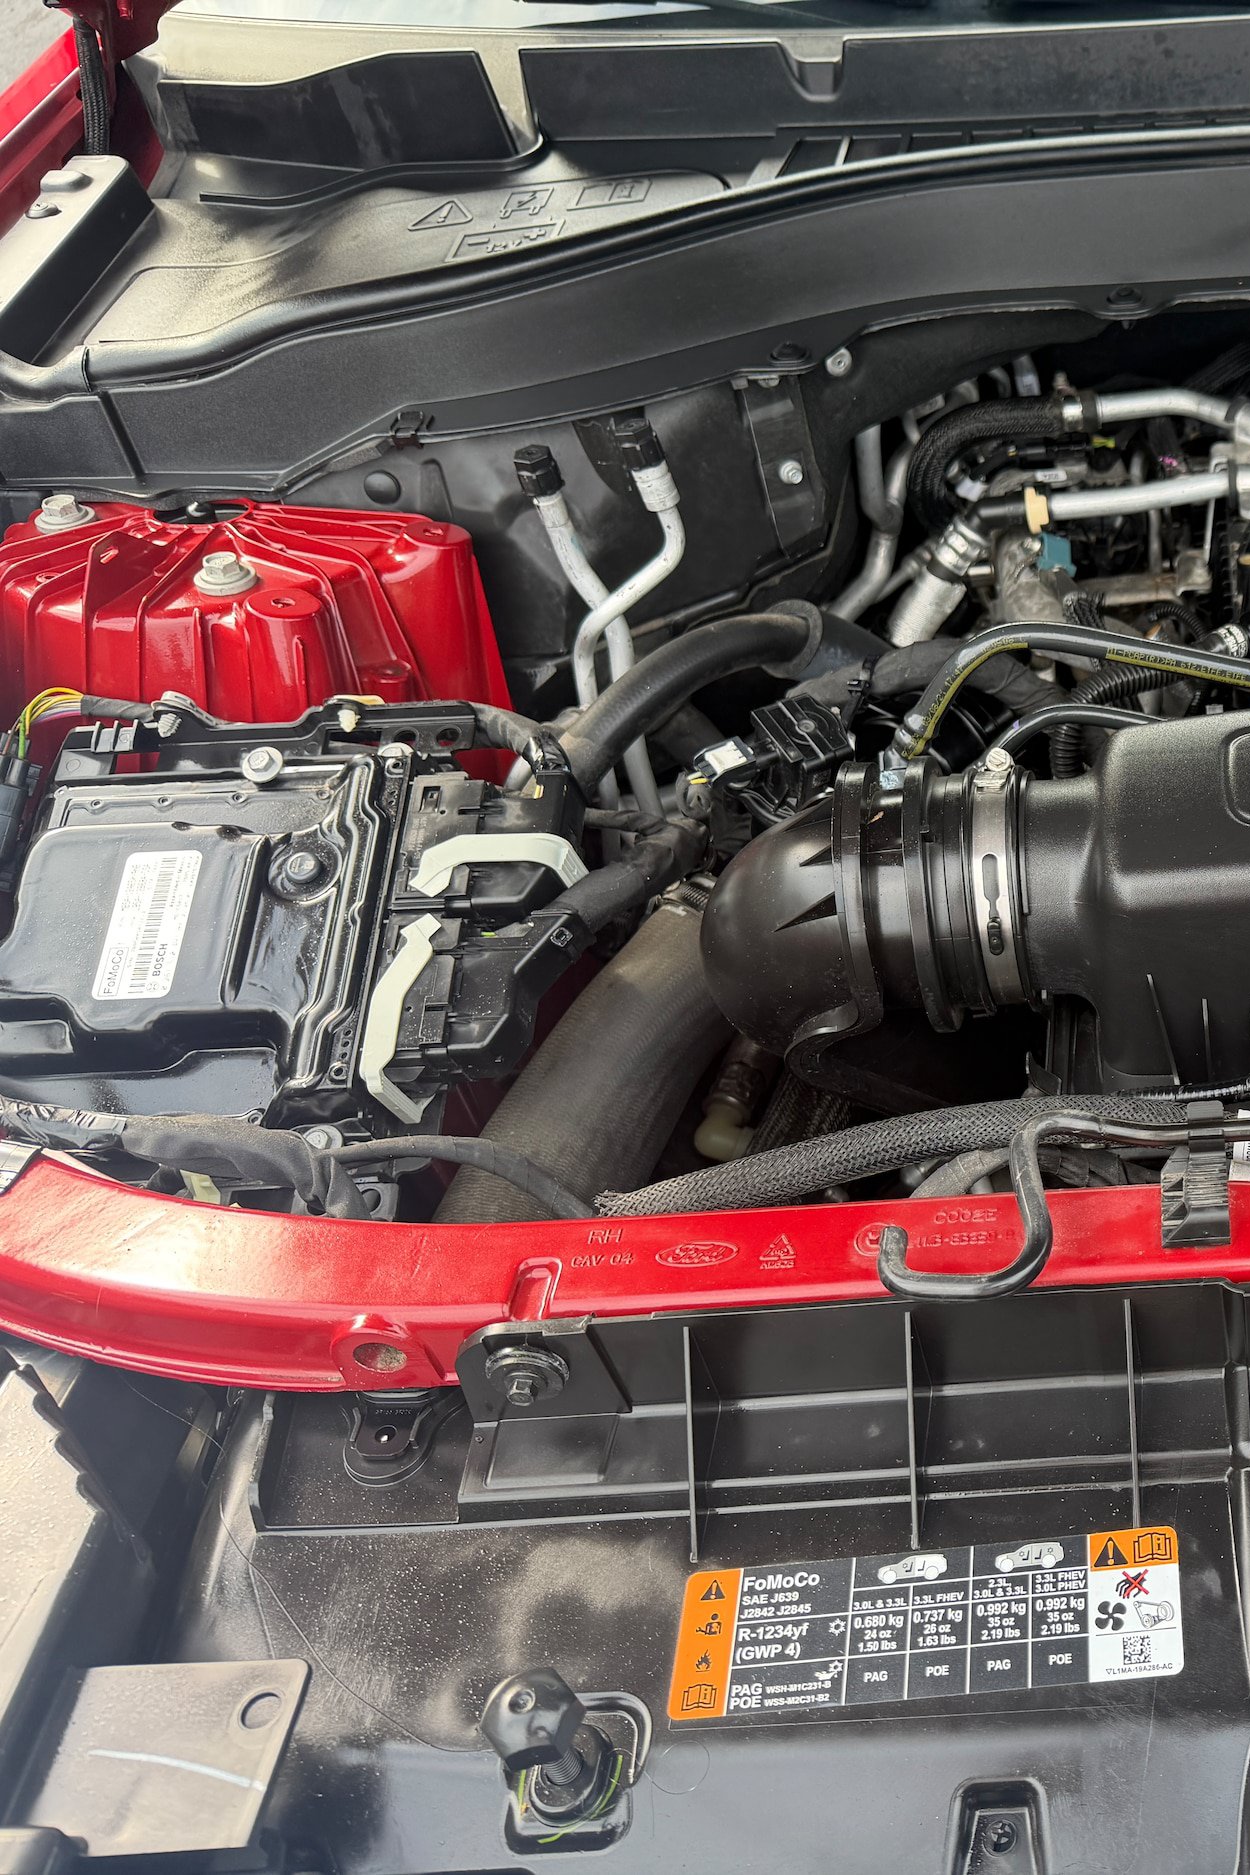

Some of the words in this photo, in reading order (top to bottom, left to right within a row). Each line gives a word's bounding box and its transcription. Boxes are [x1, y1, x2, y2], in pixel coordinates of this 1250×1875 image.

[152, 943, 168, 977] BOSCH
[103, 949, 125, 995] FoMoCo
[586, 1228, 624, 1245] RH
[664, 1242, 730, 1266] Ford
[571, 1254, 605, 1269] CAV
[743, 1572, 820, 1592] FoMoCo
[988, 1578, 1012, 1588] 2.3L,
[1035, 1573, 1056, 1584] 3.3L
[1058, 1570, 1086, 1581] FHEV
[973, 1589, 994, 1599] 3.0L
[996, 1588, 1005, 1597] &
[1006, 1585, 1027, 1596] 3.3L
[1035, 1583, 1056, 1593] 3.0L
[1058, 1580, 1086, 1591] PHEV
[742, 1594, 769, 1606] SAE
[770, 1592, 799, 1603] J639
[853, 1601, 875, 1611] 3.0L
[876, 1599, 885, 1608] &
[886, 1597, 908, 1608] 3.3L
[914, 1594, 934, 1605] 3.3L
[936, 1592, 964, 1602] FHEV
[1035, 1597, 1067, 1612] 0.992
[1069, 1596, 1085, 1610] kg
[740, 1606, 775, 1619] J2842
[777, 1604, 812, 1617] J2845
[913, 1609, 945, 1624] 0.737
[947, 1608, 963, 1622] kg
[976, 1602, 1008, 1617] 0.992
[1011, 1601, 1027, 1615] kg
[854, 1616, 886, 1629] 0.680
[888, 1614, 904, 1629] kg
[987, 1617, 1001, 1627] 35
[1002, 1617, 1015, 1626] oz
[1047, 1612, 1060, 1622] 35
[1061, 1612, 1075, 1621] oz
[737, 1623, 810, 1642] R-1234yf
[864, 1629, 878, 1640] 24
[879, 1630, 892, 1638] oz
[923, 1623, 937, 1634] 26
[938, 1624, 951, 1633] oz
[981, 1629, 1003, 1640] 2.19
[1005, 1627, 1021, 1638] lbs
[1041, 1624, 1062, 1635] 2.19
[1064, 1622, 1080, 1633] lbs
[858, 1641, 880, 1652] 1.50
[881, 1640, 897, 1651] lbs
[917, 1635, 939, 1647] 1.63
[940, 1634, 957, 1645] lbs
[735, 1645, 783, 1664] (GWP
[785, 1642, 801, 1659] 4)
[1048, 1653, 1073, 1666] POE
[925, 1665, 950, 1677] POE
[987, 1659, 1011, 1671] PAG
[863, 1671, 888, 1682] PAG
[731, 1683, 763, 1696] PAG
[730, 1696, 762, 1710] POE
